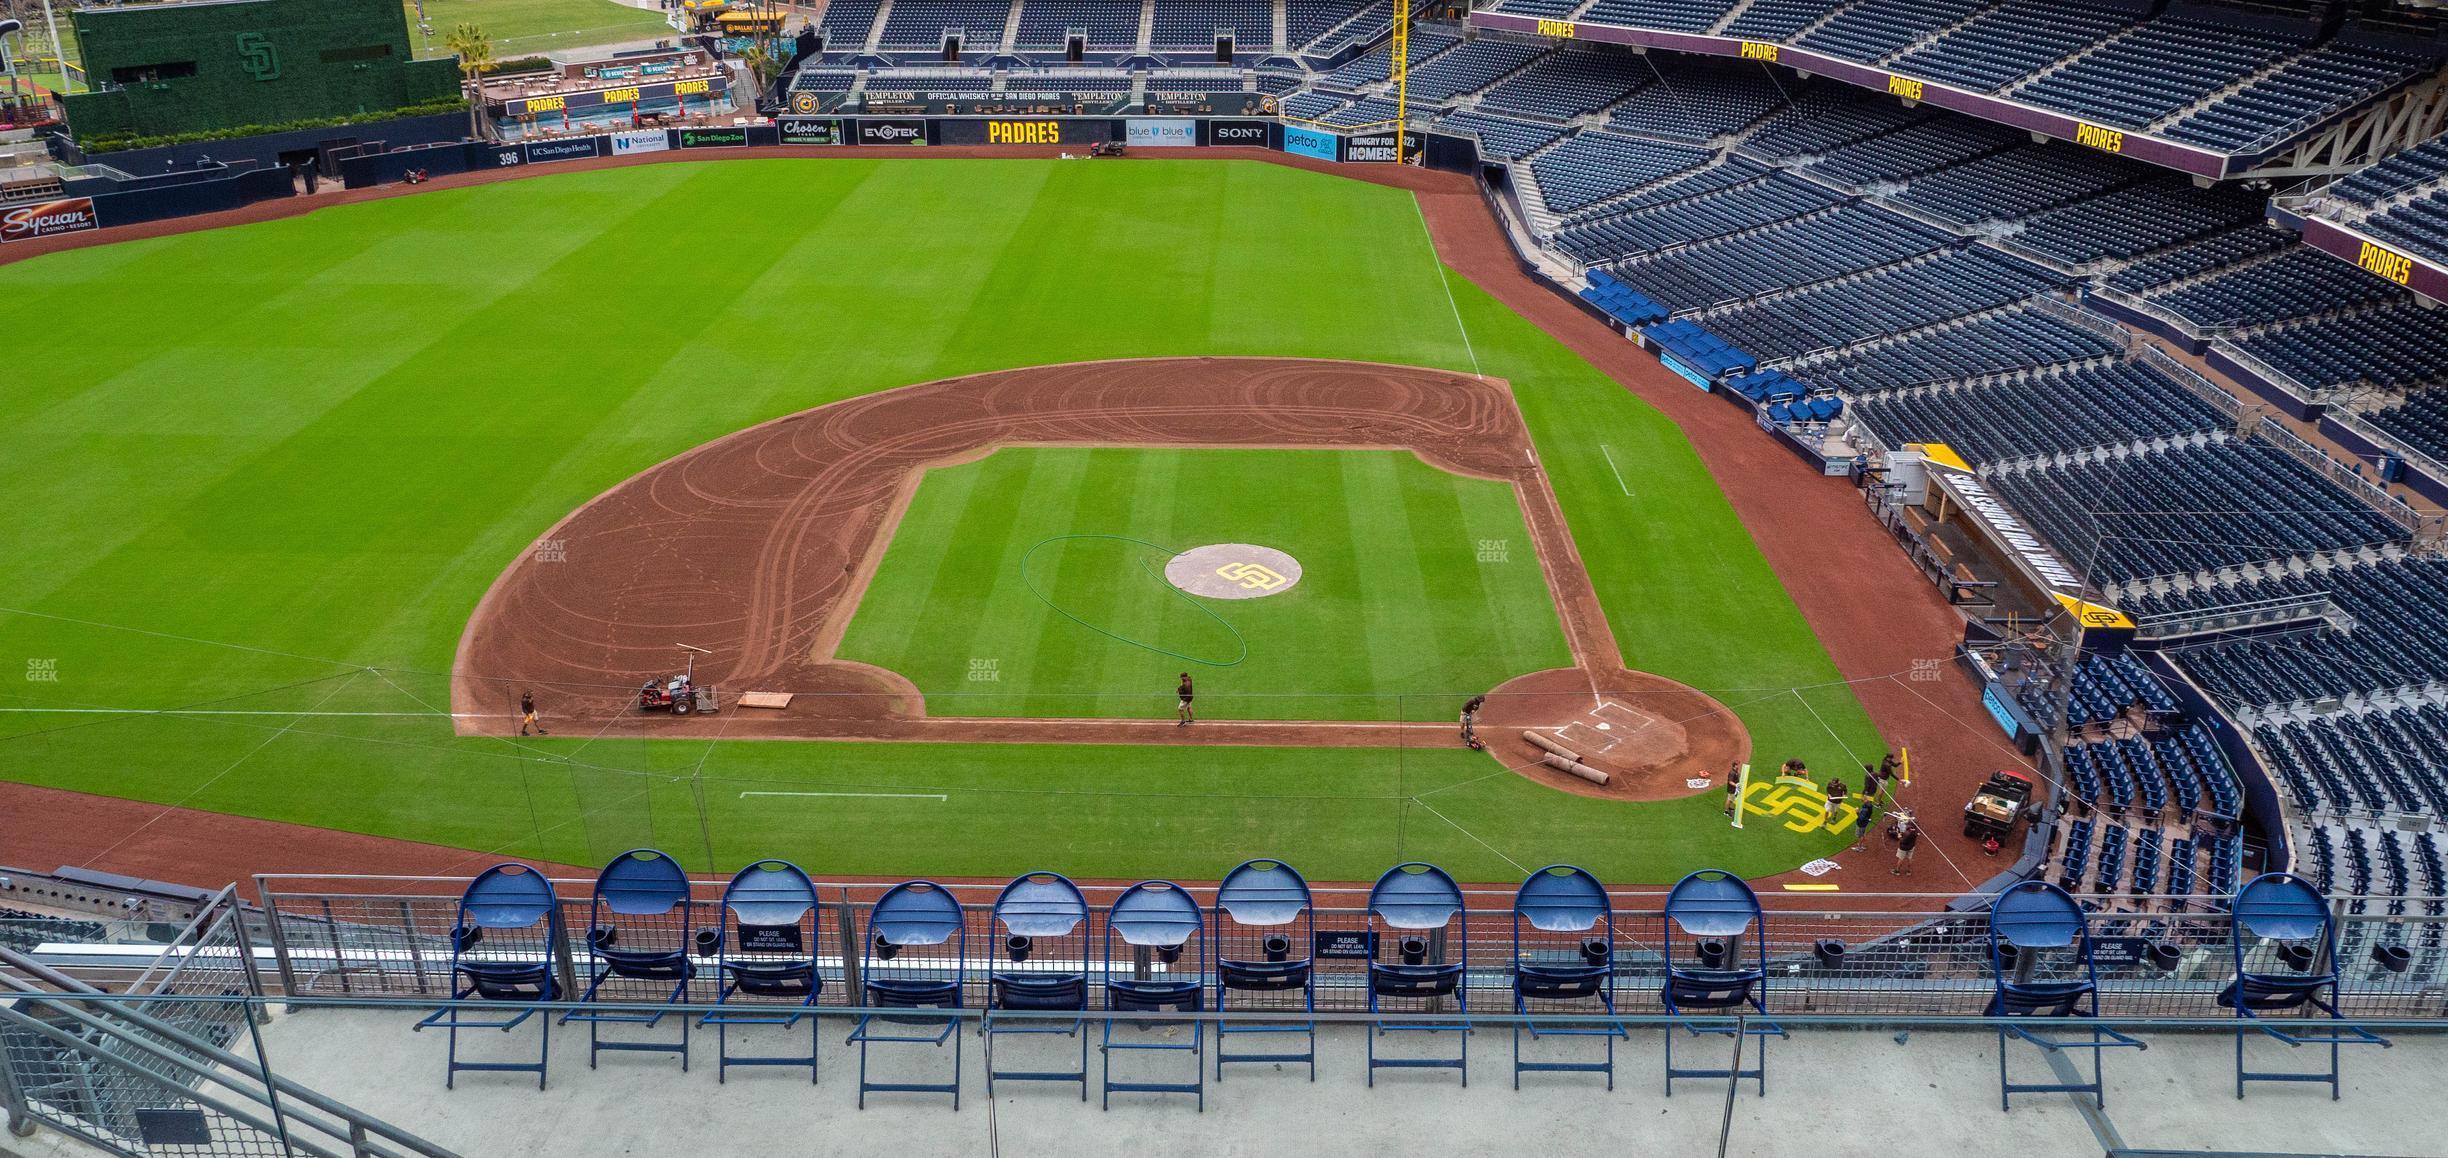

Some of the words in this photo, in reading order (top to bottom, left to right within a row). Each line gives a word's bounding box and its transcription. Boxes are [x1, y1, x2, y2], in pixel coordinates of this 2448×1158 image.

[1537, 20, 1575, 38] PADRES
[1741, 41, 1779, 62] PADRES
[675, 80, 709, 95] PADRES
[1888, 75, 1923, 100] PADRES
[603, 88, 640, 103] PADRES
[864, 91, 915, 100] TEMPLETON
[927, 92, 957, 100] OFFICIAL
[958, 92, 989, 100] WHISKEY
[1005, 92, 1018, 100] SAN
[1018, 92, 1036, 100] DIEGO
[1037, 92, 1060, 100] PADRES
[1072, 92, 1123, 100] TEMPLETON
[1155, 92, 1207, 101] TEMPLETON
[527, 97, 565, 113] PADRES
[784, 120, 827, 133] Chosen
[865, 125, 919, 139] EVOTEK
[989, 121, 1059, 144] PADRES
[1128, 127, 1150, 136] blue
[1162, 127, 1183, 136] blue
[1218, 128, 1262, 138] SONY
[631, 134, 664, 144] National
[710, 134, 730, 143] Diego
[1287, 133, 1318, 149] petco
[1352, 137, 1380, 146] HUNGRY
[1380, 137, 1395, 146] FOR
[2076, 122, 2123, 153] PADRES
[533, 148, 543, 156] UC
[543, 147, 555, 155] San
[555, 146, 571, 154] Diego
[572, 143, 592, 152] Health
[1348, 147, 1398, 161] HOMERS
[500, 151, 519, 165] 396
[3, 208, 87, 235] Sycuan
[41, 225, 65, 233] CASINO
[2358, 241, 2412, 285] PADRES
[1216, 562, 1287, 590] SD
